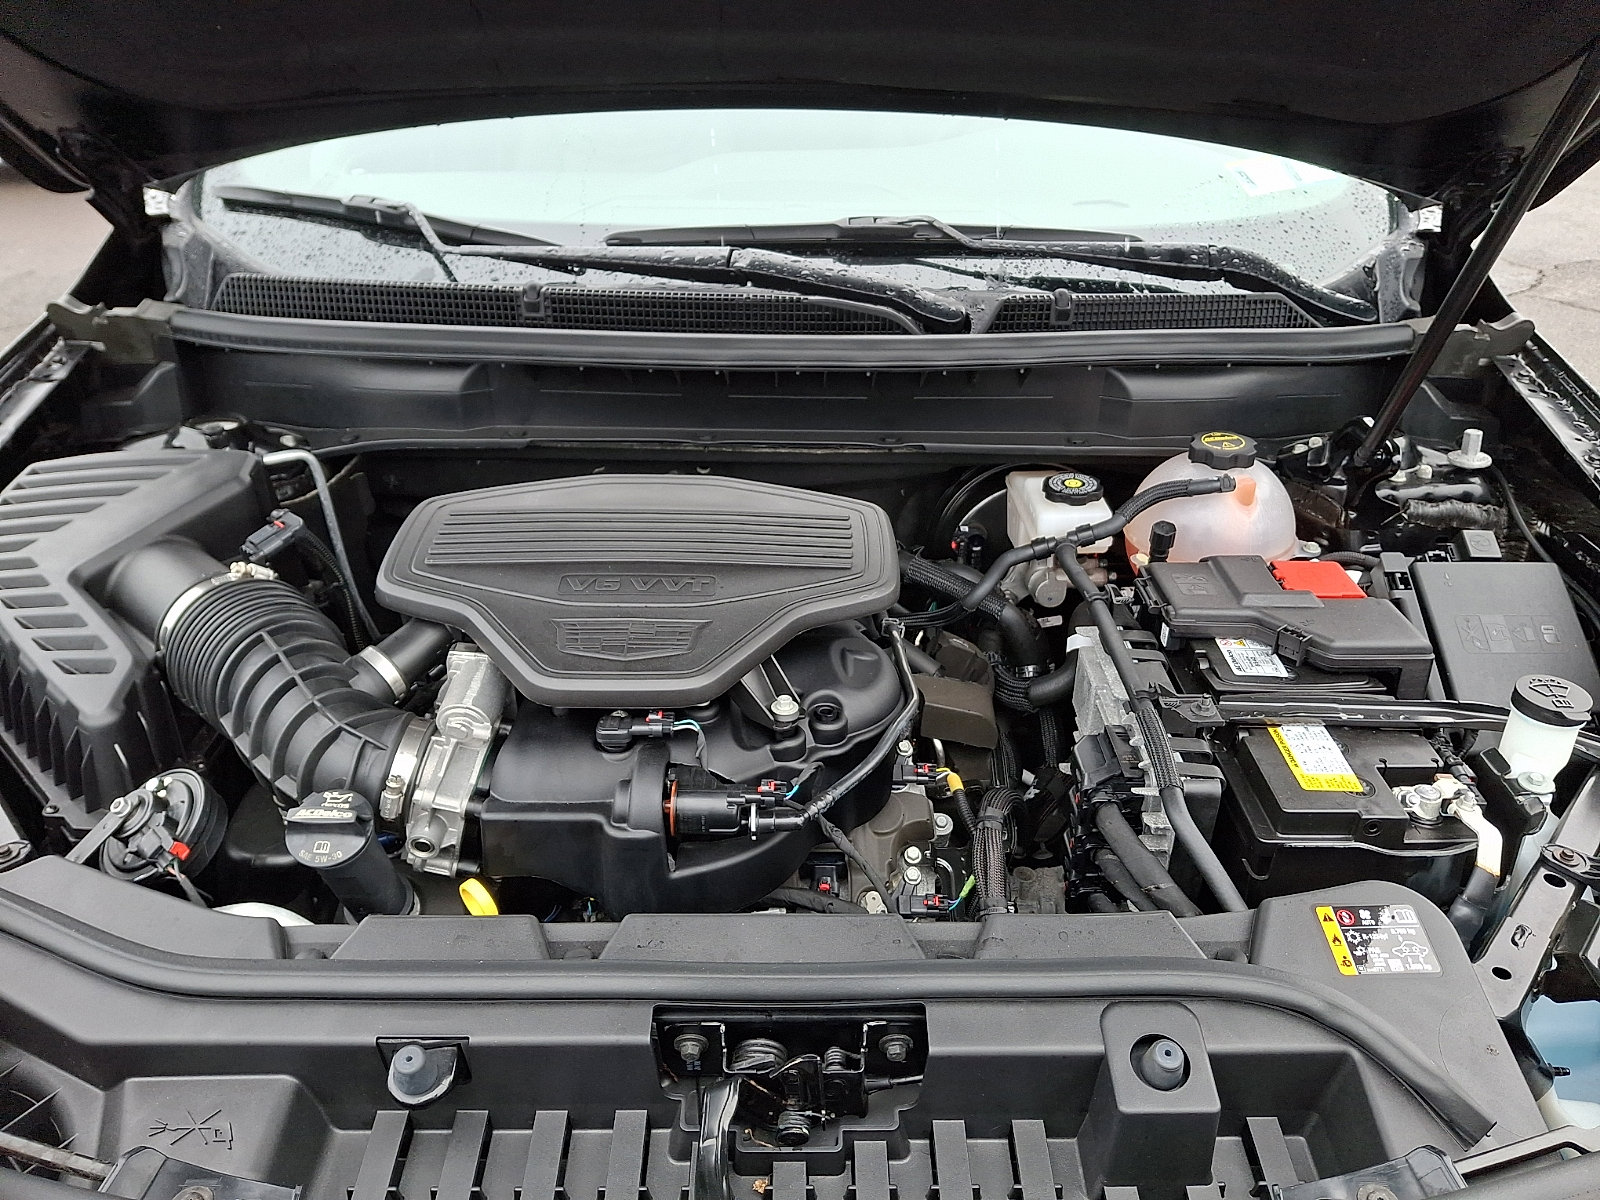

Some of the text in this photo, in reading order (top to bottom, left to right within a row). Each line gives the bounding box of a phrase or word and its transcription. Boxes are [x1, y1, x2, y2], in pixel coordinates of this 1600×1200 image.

[566, 577, 710, 592] V6 VVT
[295, 809, 353, 818] ACDelco
[299, 849, 343, 863] SAE 5W-30
